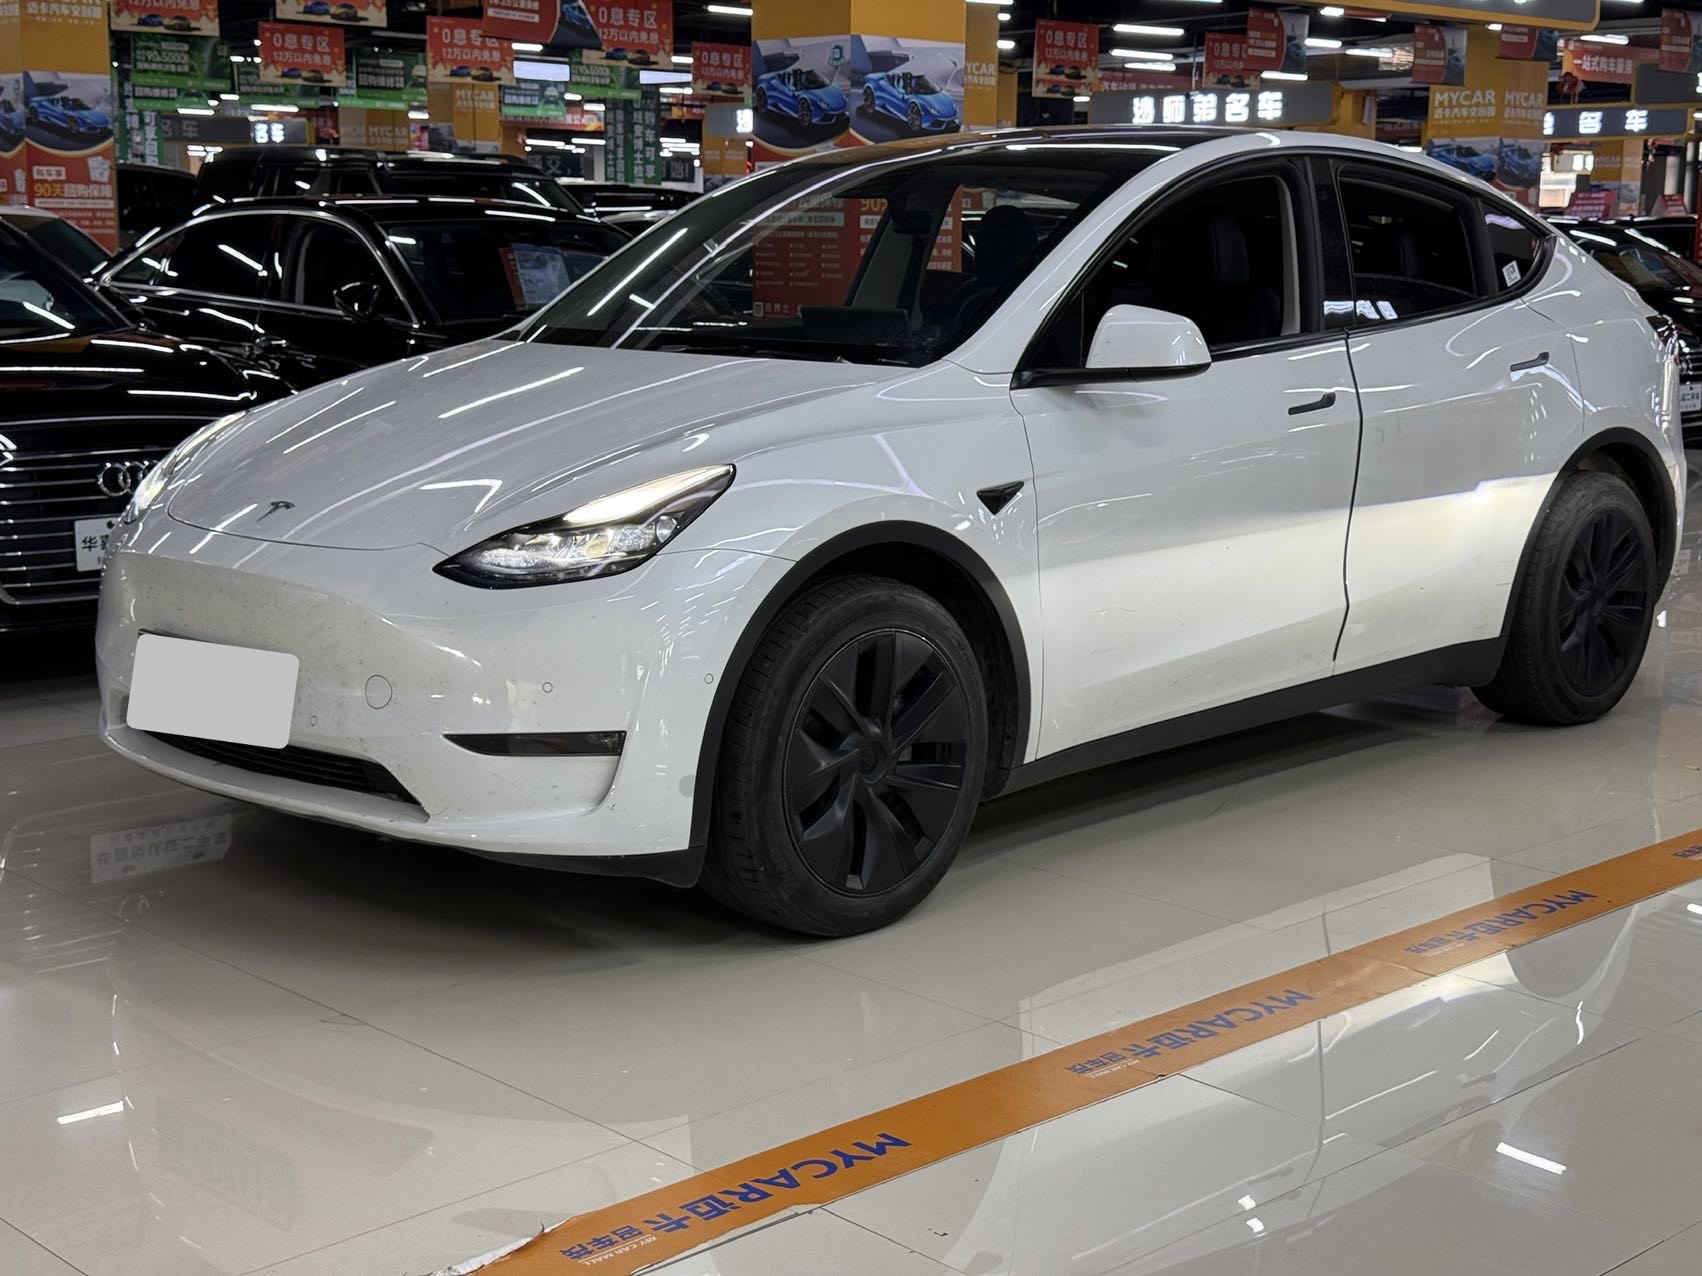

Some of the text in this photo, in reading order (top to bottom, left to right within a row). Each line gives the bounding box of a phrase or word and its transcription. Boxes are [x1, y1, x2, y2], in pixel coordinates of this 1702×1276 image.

[600, 7, 657, 28] 0息专区
[273, 33, 331, 52] 0息专区
[1045, 30, 1088, 48] 0息专区
[442, 48, 500, 61] 12万以内免息
[965, 62, 996, 76] YCAR
[1435, 89, 1496, 107] MYCAR
[1504, 91, 1543, 107] MYCAR
[34, 182, 113, 198] 90天回购保障
[1121, 989, 1315, 1058] MYCAR迈卡
[641, 1132, 912, 1233] MYCAR迈卡
[580, 1235, 657, 1266] MY CAR MALL
